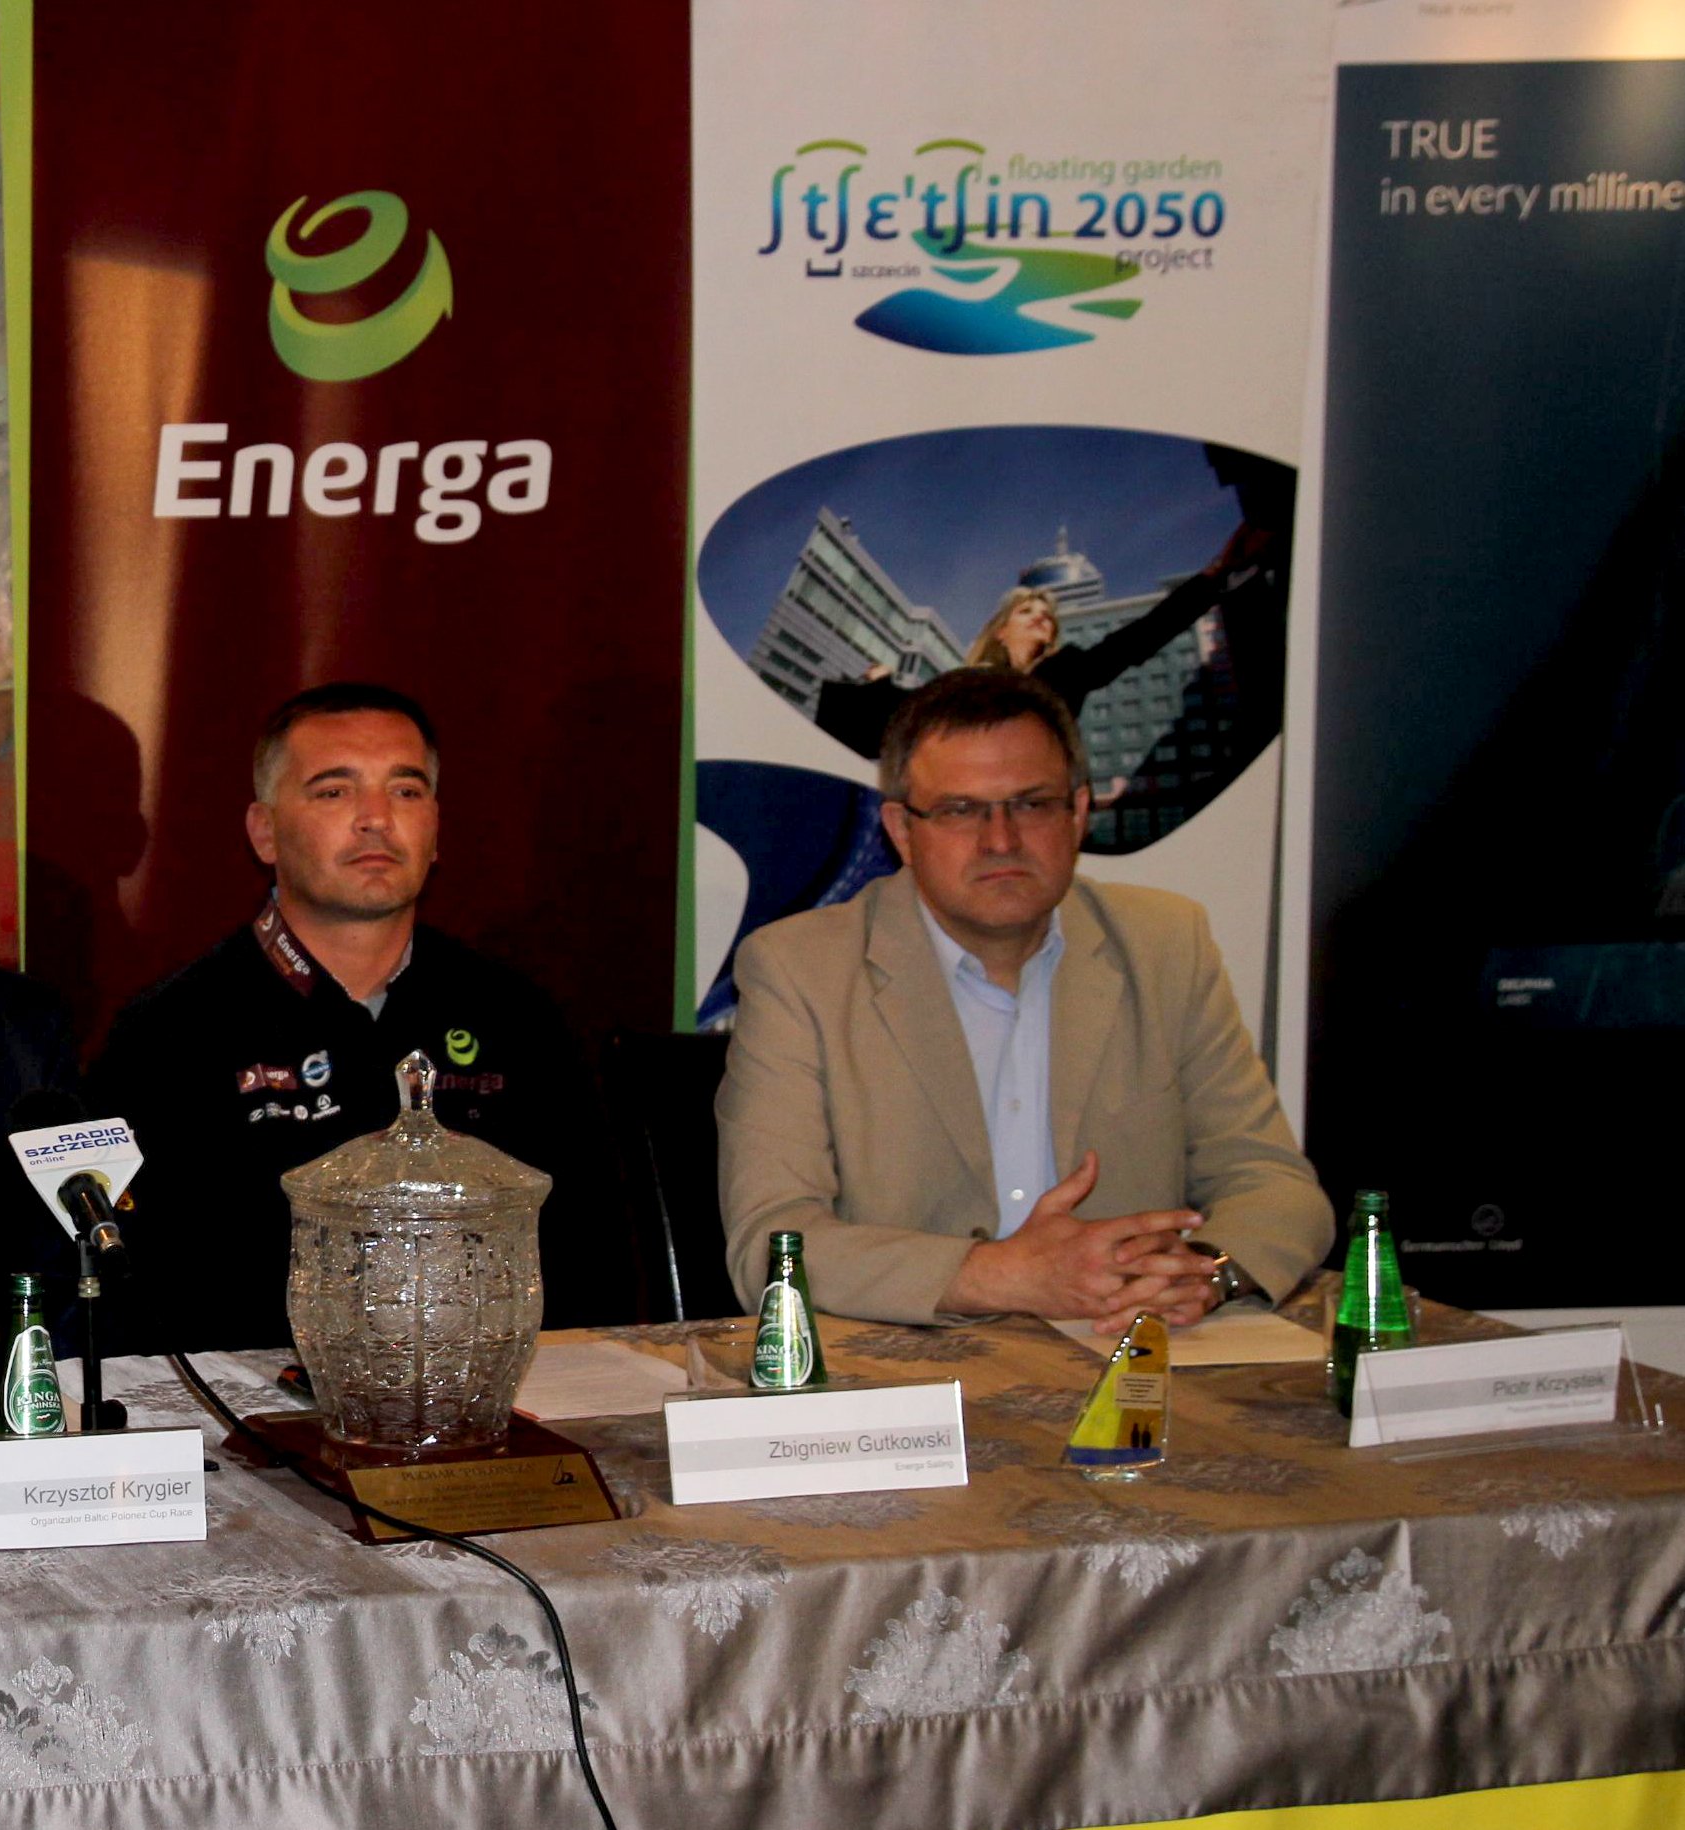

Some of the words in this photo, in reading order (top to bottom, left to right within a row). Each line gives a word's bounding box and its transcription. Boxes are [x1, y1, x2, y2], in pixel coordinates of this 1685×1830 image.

[1380, 117, 1501, 161] TRUE
[1007, 153, 1115, 187] floating
[1122, 153, 1223, 187] garden
[1073, 189, 1227, 241] 2050
[1379, 177, 1416, 216] in
[1424, 183, 1541, 222] every
[1114, 244, 1214, 275] project
[153, 422, 552, 544] Energa
[277, 932, 311, 976] Energa
[24, 1136, 130, 1158] SZCZECIN
[58, 1126, 127, 1143] RADIO
[1493, 1380, 1531, 1397] Piotr
[769, 1437, 852, 1462] Zbigniew
[858, 1429, 953, 1454] Gutkowski
[24, 1481, 116, 1507] Krzysztof
[121, 1478, 192, 1502] Krygier
[30, 1514, 83, 1528] Organizator
[84, 1511, 109, 1523] Baltic
[111, 1510, 147, 1522] Polonez
[149, 1509, 168, 1521] Cup
[170, 1507, 193, 1518] Race
